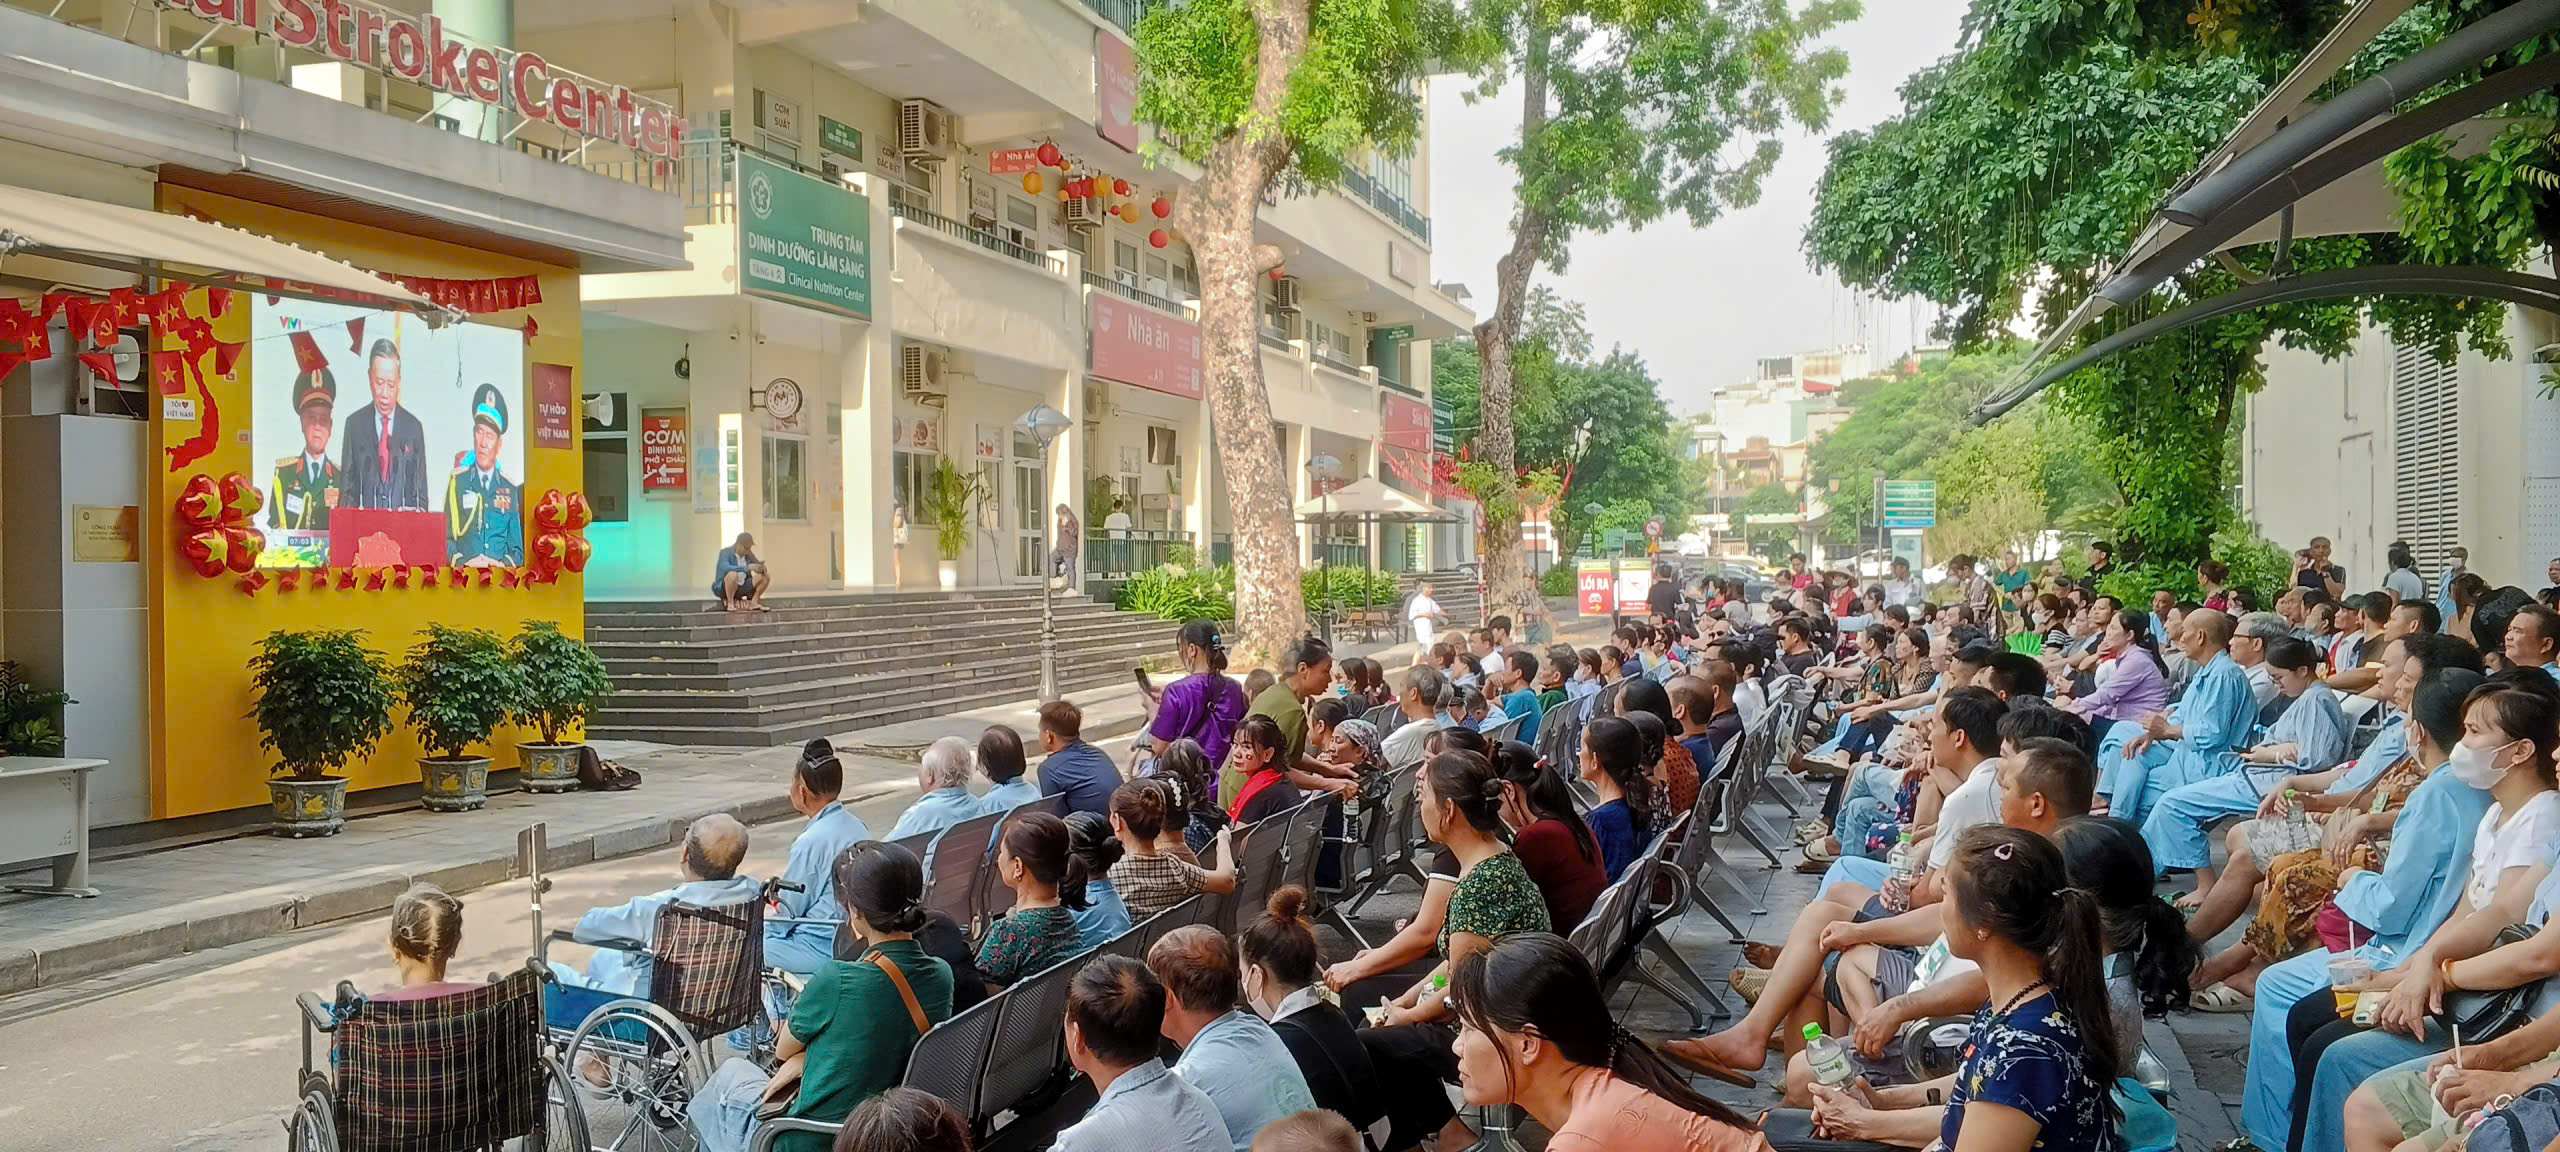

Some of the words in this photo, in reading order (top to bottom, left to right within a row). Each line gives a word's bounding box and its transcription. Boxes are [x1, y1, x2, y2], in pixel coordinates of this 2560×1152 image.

[273, 0, 499, 103] Stroke
[512, 52, 687, 161] Center
[748, 231, 776, 256] DINH
[777, 240, 816, 267] DƯỠNG
[817, 250, 839, 273] LÂM
[839, 256, 865, 280] SÀNG
[810, 225, 844, 250] TRUNG
[844, 234, 864, 256] TÂM
[788, 272, 813, 291] Clinical
[814, 279, 844, 298] Nutrition
[844, 286, 865, 303] Center
[1127, 313, 1153, 347] Nhà
[553, 428, 570, 440] NAM
[643, 429, 686, 445] CƠM
[647, 445, 666, 455] BÌNH
[1580, 574, 1596, 591] LỐI
[1596, 577, 1610, 591] RA
